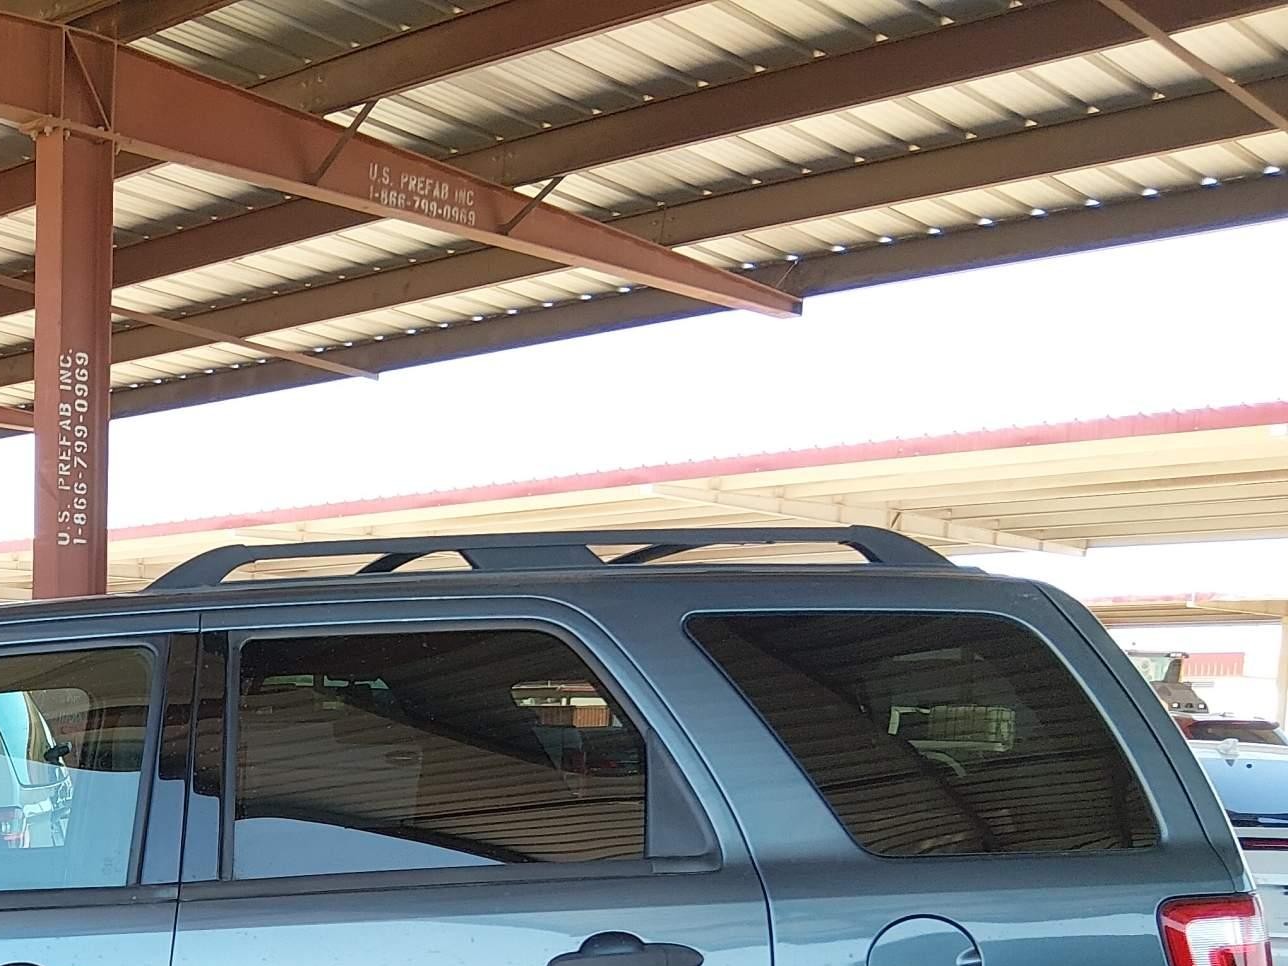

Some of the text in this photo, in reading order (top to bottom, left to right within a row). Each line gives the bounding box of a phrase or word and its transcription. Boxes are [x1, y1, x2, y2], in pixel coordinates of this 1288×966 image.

[369, 162, 393, 186] U.S.
[400, 172, 449, 201] PREFAB
[369, 185, 476, 226] 1-866-799-0969
[58, 348, 73, 546] U.S. PREFAB INC.
[73, 352, 89, 545] 1-866-799-0969
